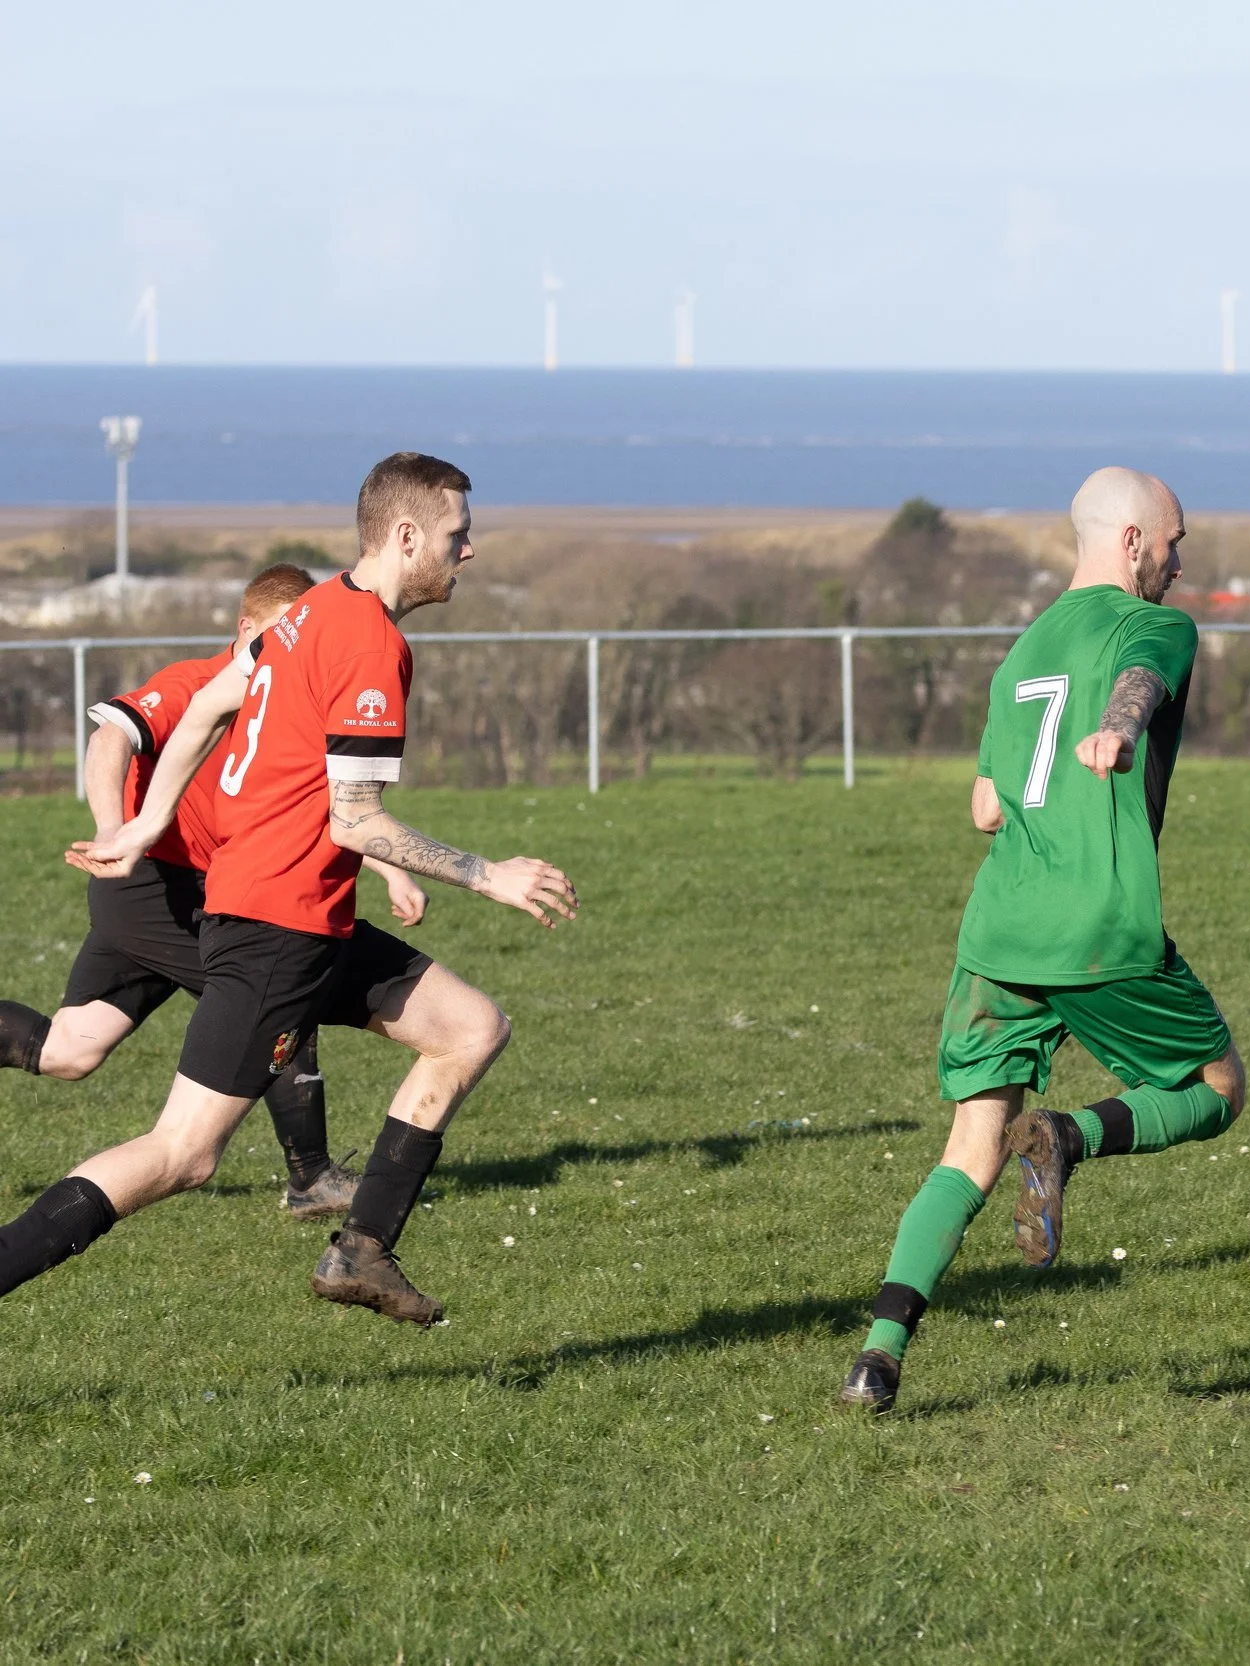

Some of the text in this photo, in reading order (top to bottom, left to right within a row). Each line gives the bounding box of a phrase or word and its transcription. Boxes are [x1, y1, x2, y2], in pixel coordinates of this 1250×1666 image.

[219, 664, 272, 797] 3
[359, 719, 382, 727] ROYAL
[1015, 674, 1069, 809] 7
